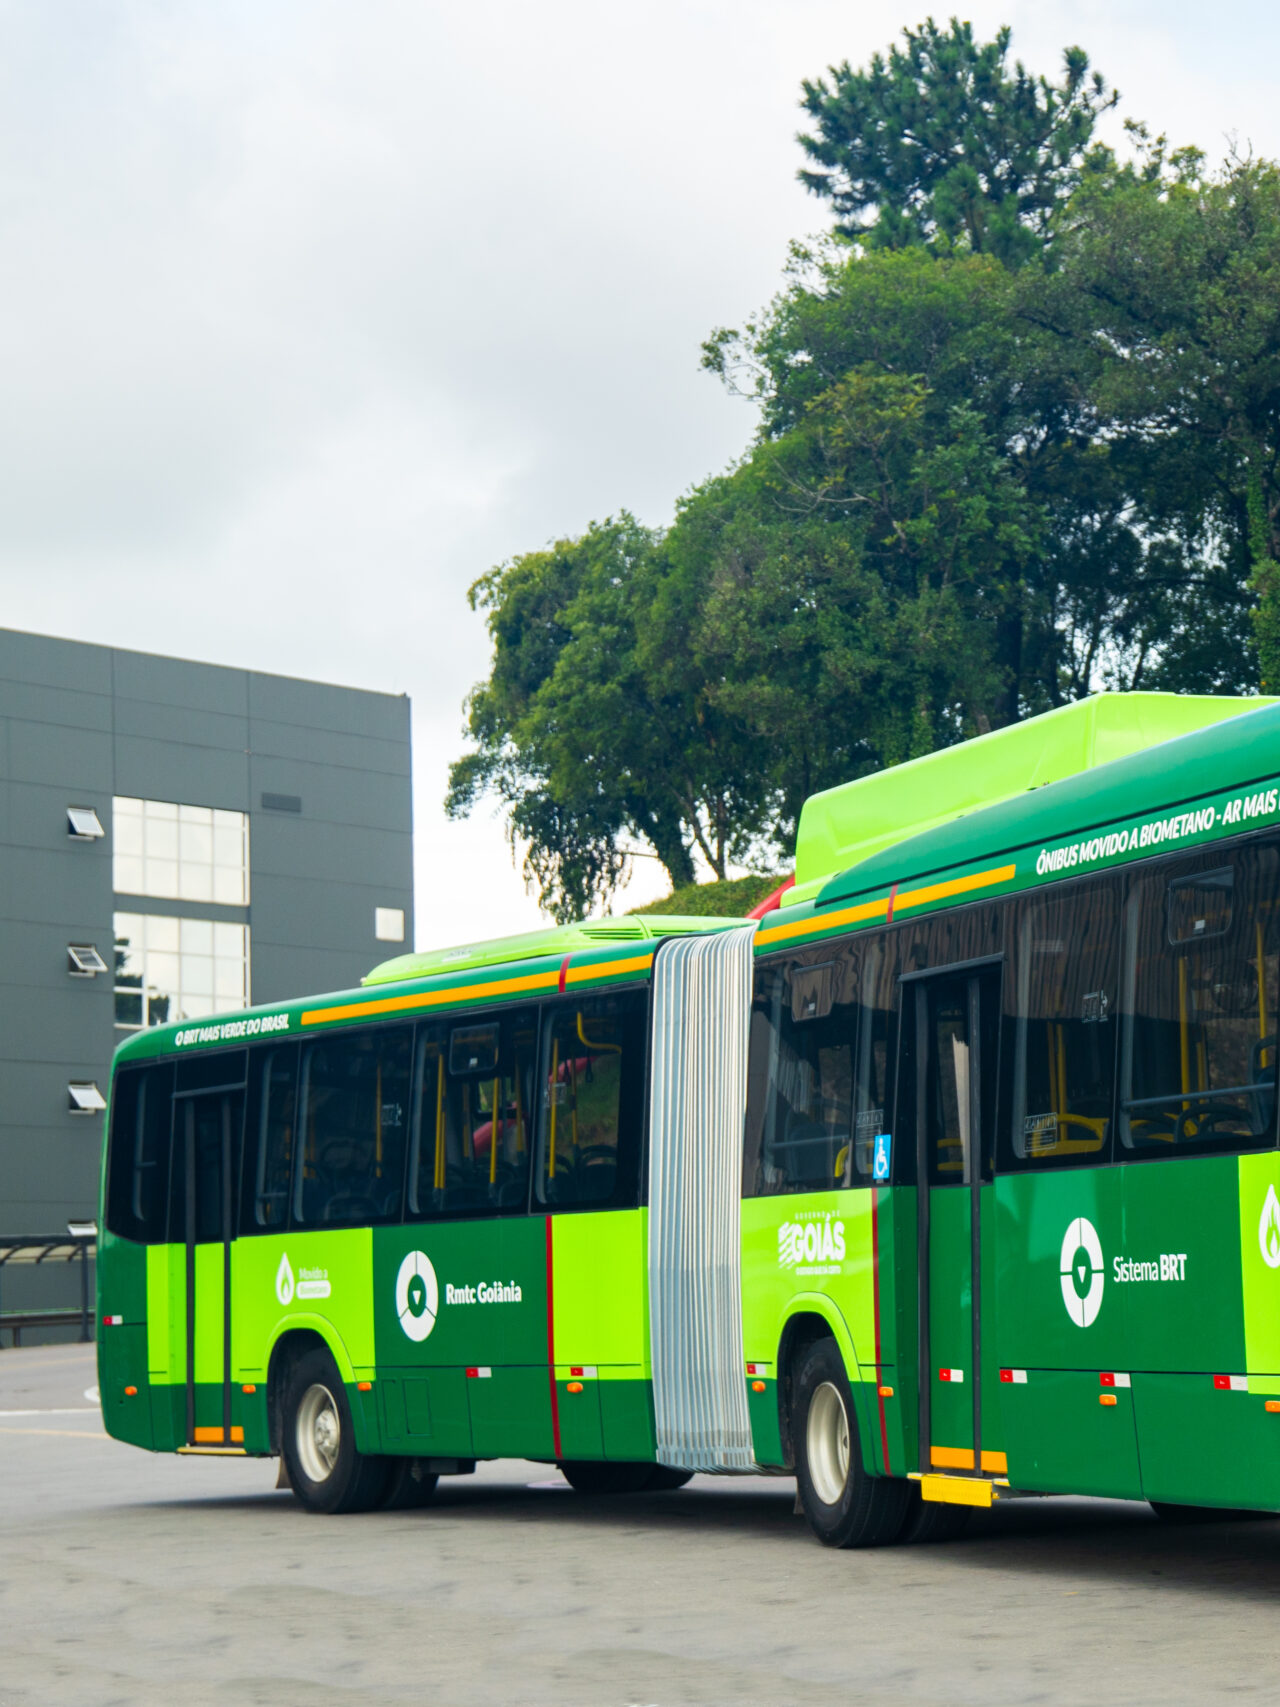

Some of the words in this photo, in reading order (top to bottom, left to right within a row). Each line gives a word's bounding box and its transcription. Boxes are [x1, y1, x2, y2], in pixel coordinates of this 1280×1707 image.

[1036, 843, 1080, 876] ÔNIBUS
[1079, 830, 1129, 864] MOVIDO
[1128, 827, 1139, 850] A
[1139, 807, 1216, 848] BIOMETANO
[1221, 798, 1242, 825] AR
[1242, 788, 1278, 820] MAIS
[175, 1031, 183, 1046] O
[183, 1028, 199, 1045] BRT
[198, 1025, 220, 1042] MAIS
[220, 1021, 247, 1039] VERDE
[246, 1018, 261, 1035] DO
[260, 1013, 290, 1033] BRASIL
[791, 1212, 846, 1263] GOIÁS
[1113, 1255, 1159, 1283] Sistema
[1160, 1253, 1187, 1281] BRT
[445, 1283, 476, 1304] Rmtc
[477, 1280, 522, 1304] Goiânia
